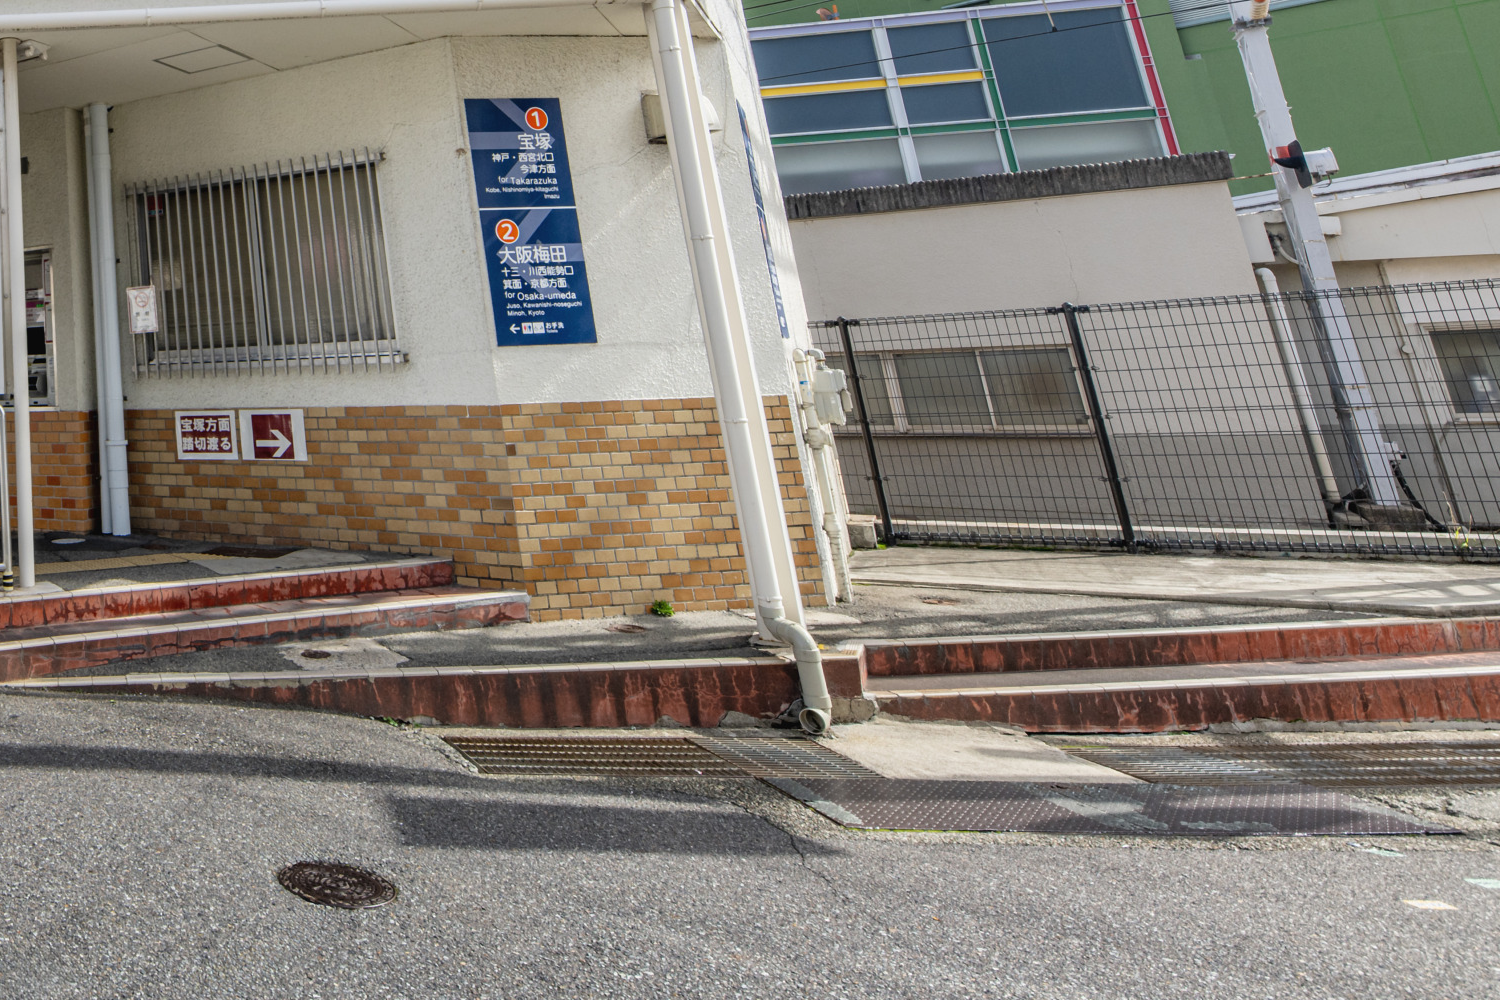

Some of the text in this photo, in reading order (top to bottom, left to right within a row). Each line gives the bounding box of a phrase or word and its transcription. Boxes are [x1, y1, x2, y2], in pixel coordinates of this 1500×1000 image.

[531, 111, 540, 127] 1
[518, 132, 552, 150] 宝塚
[492, 152, 554, 162] 神戸・西宮北口
[520, 164, 556, 174] 今津方面
[510, 176, 558, 184] Takarazuka
[501, 223, 514, 240] 2
[500, 246, 567, 264] 大阪梅田
[501, 266, 574, 277] 十三・川西能勢口
[502, 278, 567, 289] 箕面・京都方面
[517, 291, 576, 300] Osaka-umeda
[181, 418, 230, 432] 宝塚方面
[182, 437, 232, 451] 踏切渡る
